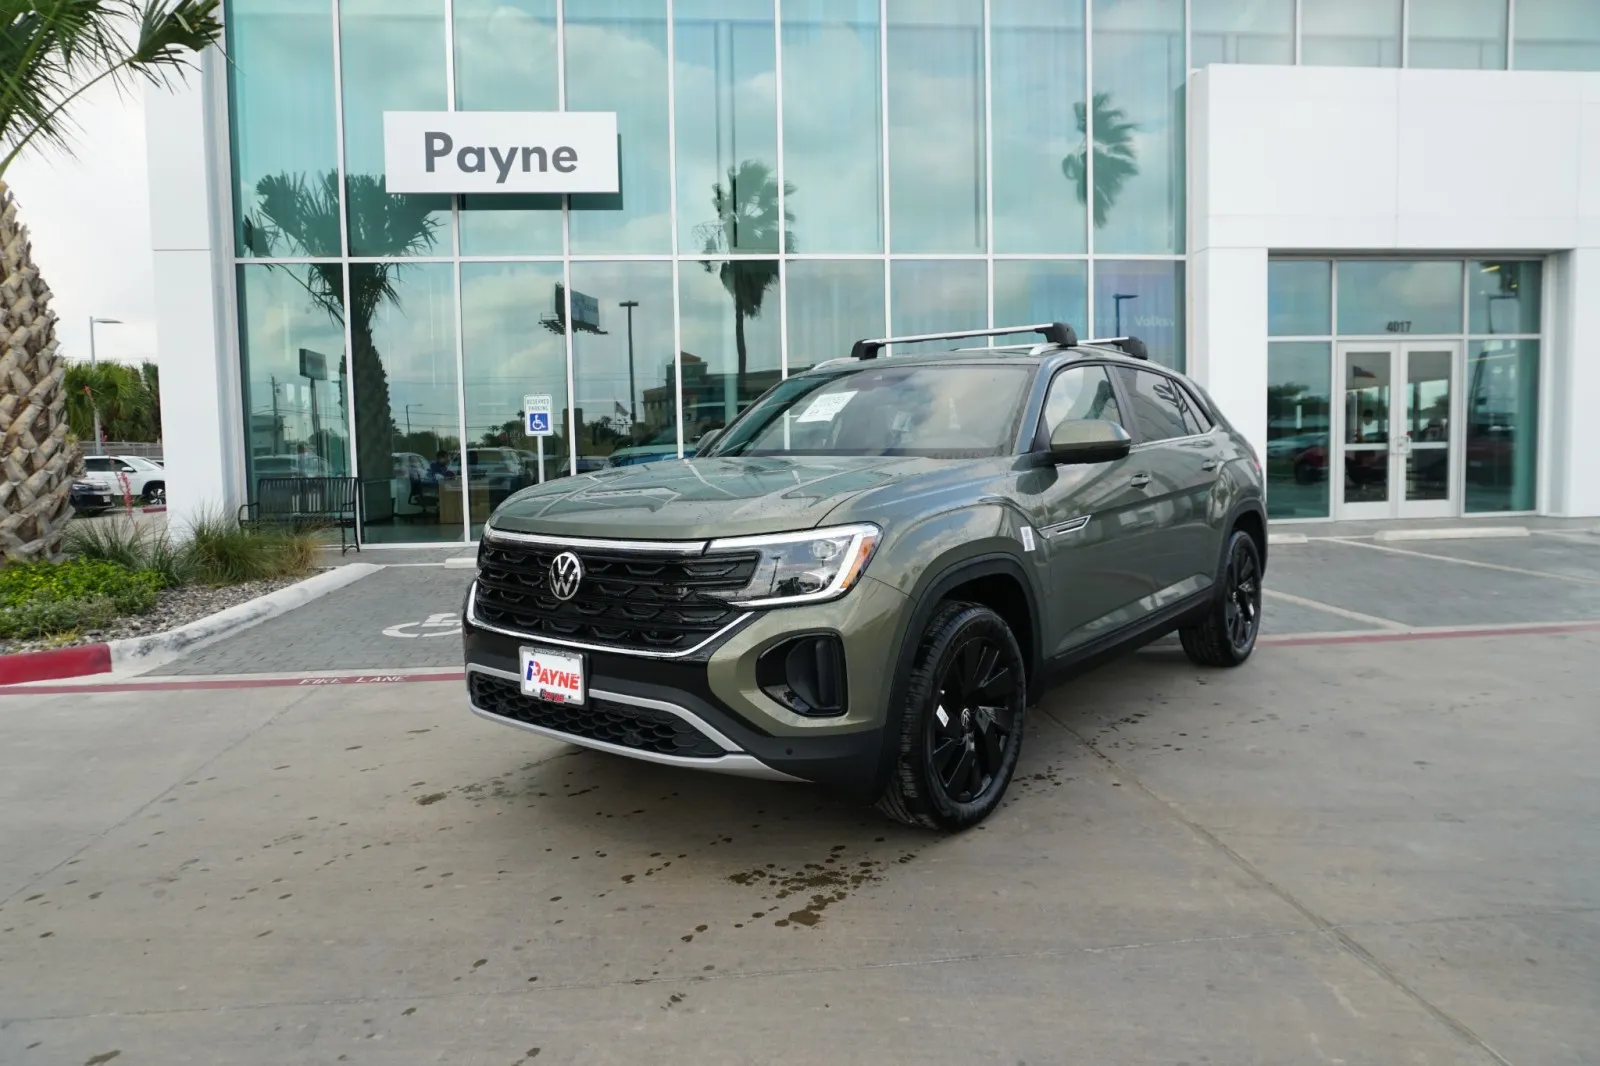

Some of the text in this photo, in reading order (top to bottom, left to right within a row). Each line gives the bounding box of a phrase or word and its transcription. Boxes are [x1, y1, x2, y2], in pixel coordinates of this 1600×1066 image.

[424, 131, 578, 184] Payne
[1386, 320, 1412, 332] 4017
[526, 660, 580, 690] PAYNE
